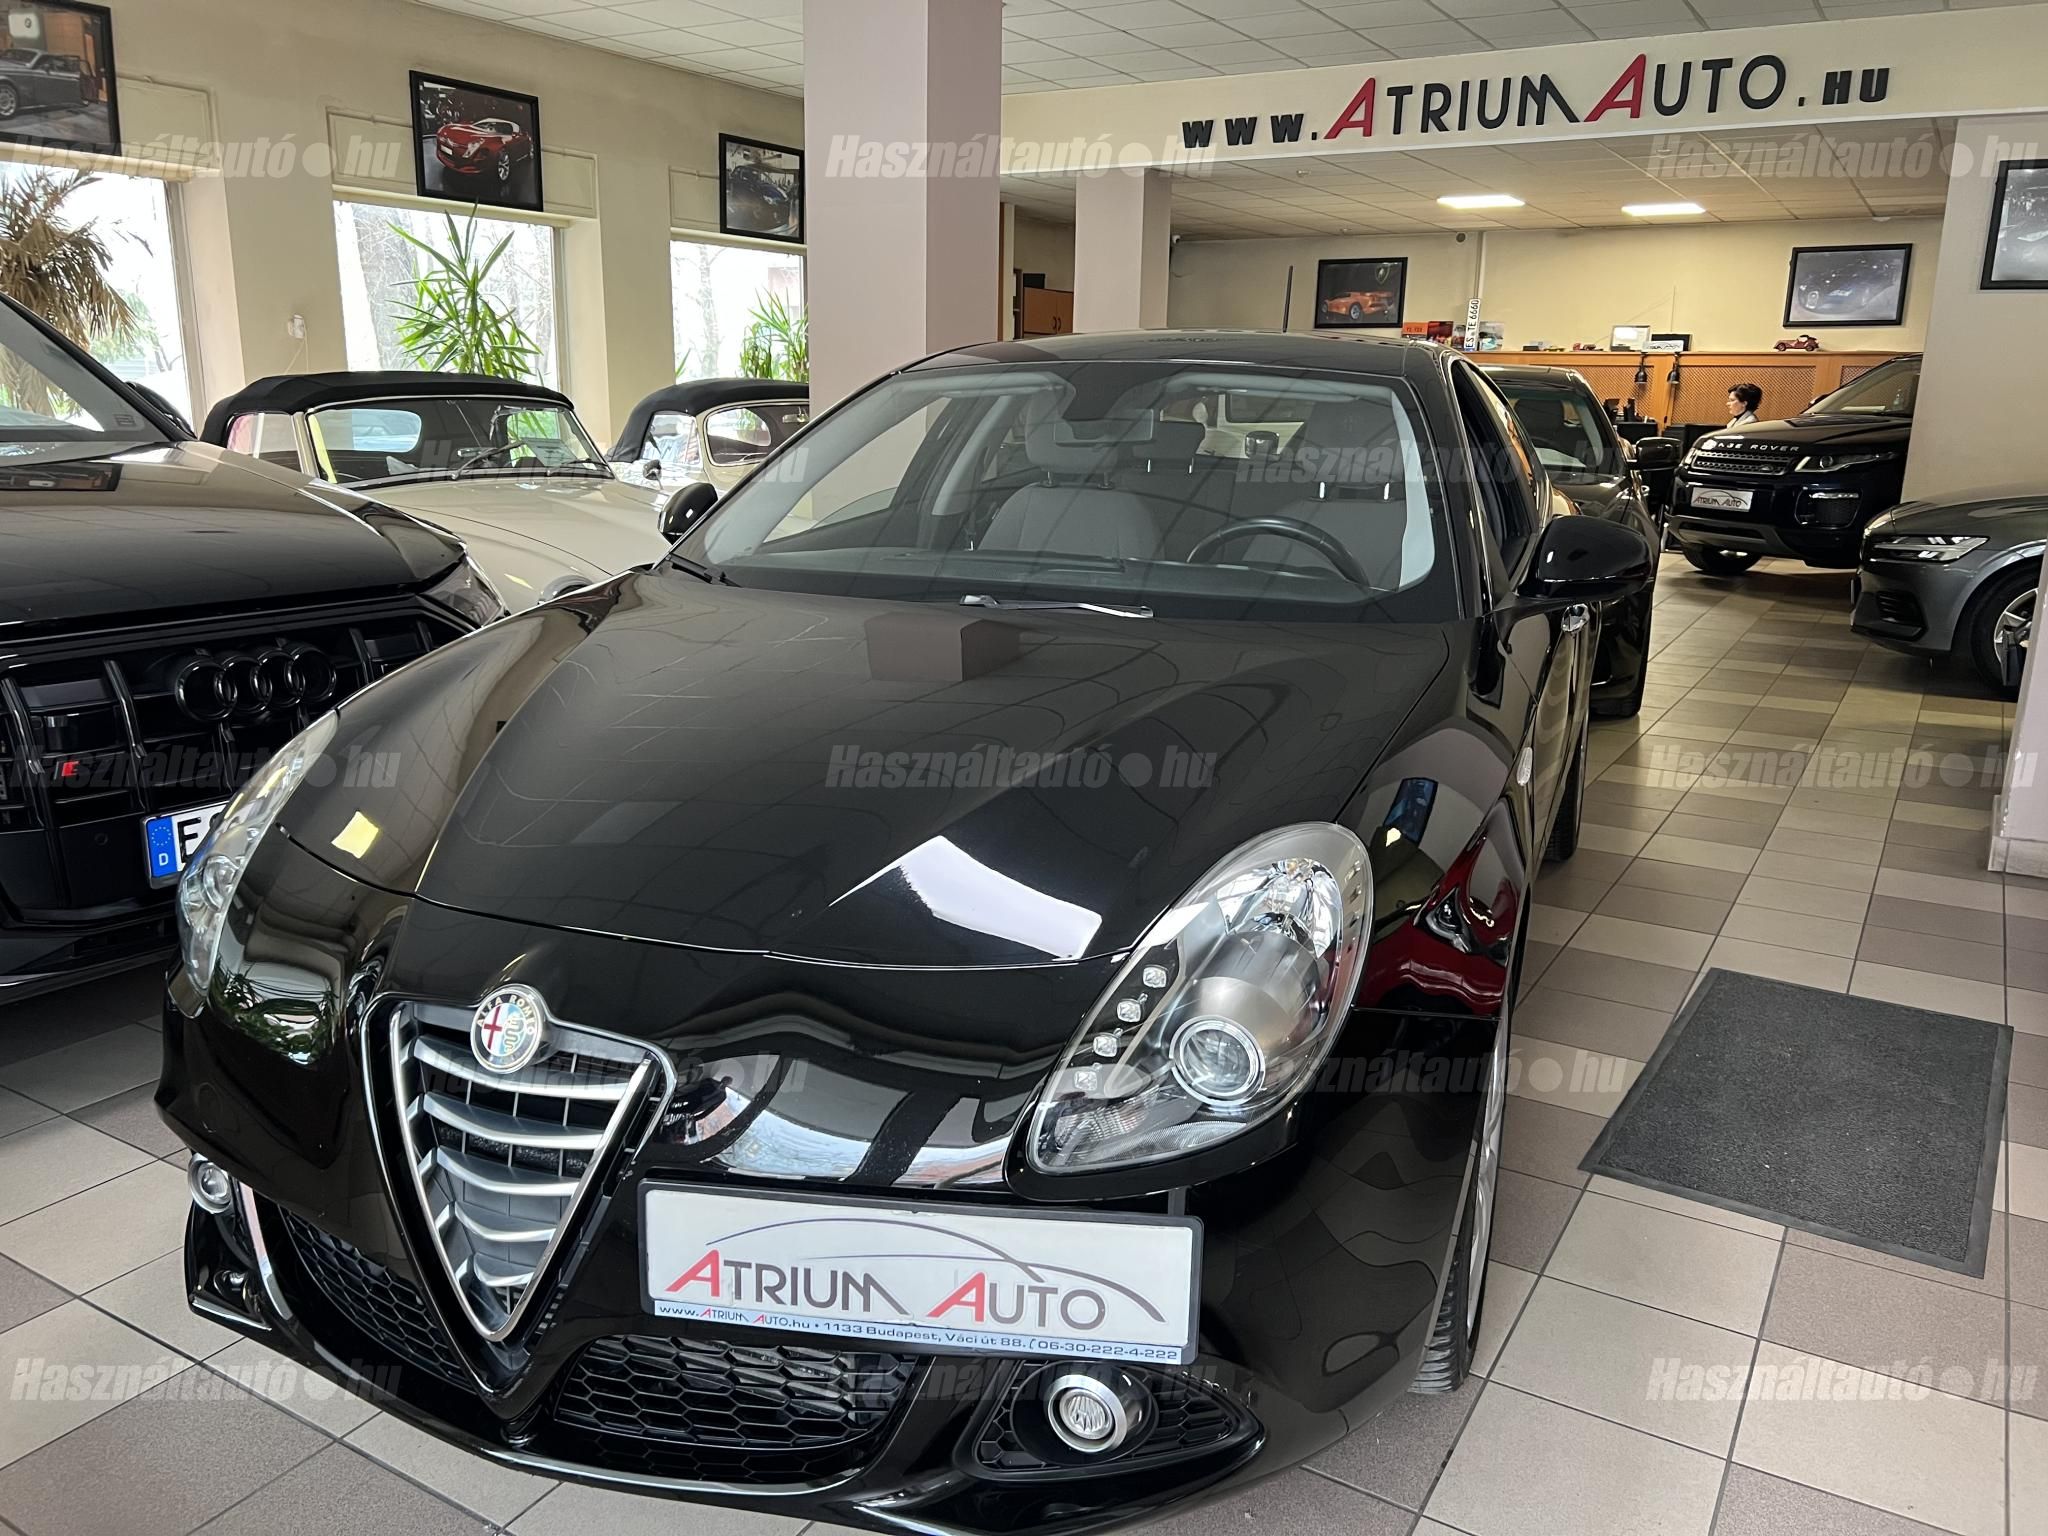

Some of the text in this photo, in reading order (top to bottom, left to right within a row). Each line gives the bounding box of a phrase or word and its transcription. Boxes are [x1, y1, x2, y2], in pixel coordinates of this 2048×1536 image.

[158, 852, 169, 866] D
[477, 994, 537, 1036] ALFA ROMEO
[665, 1249, 1107, 1330] ATRIUM AUTO
[823, 1322, 863, 1333] 1133
[866, 1326, 942, 1342] Budapest,
[945, 1332, 978, 1344] Váci
[981, 1333, 997, 1345] út
[1001, 1337, 1026, 1348] 88.
